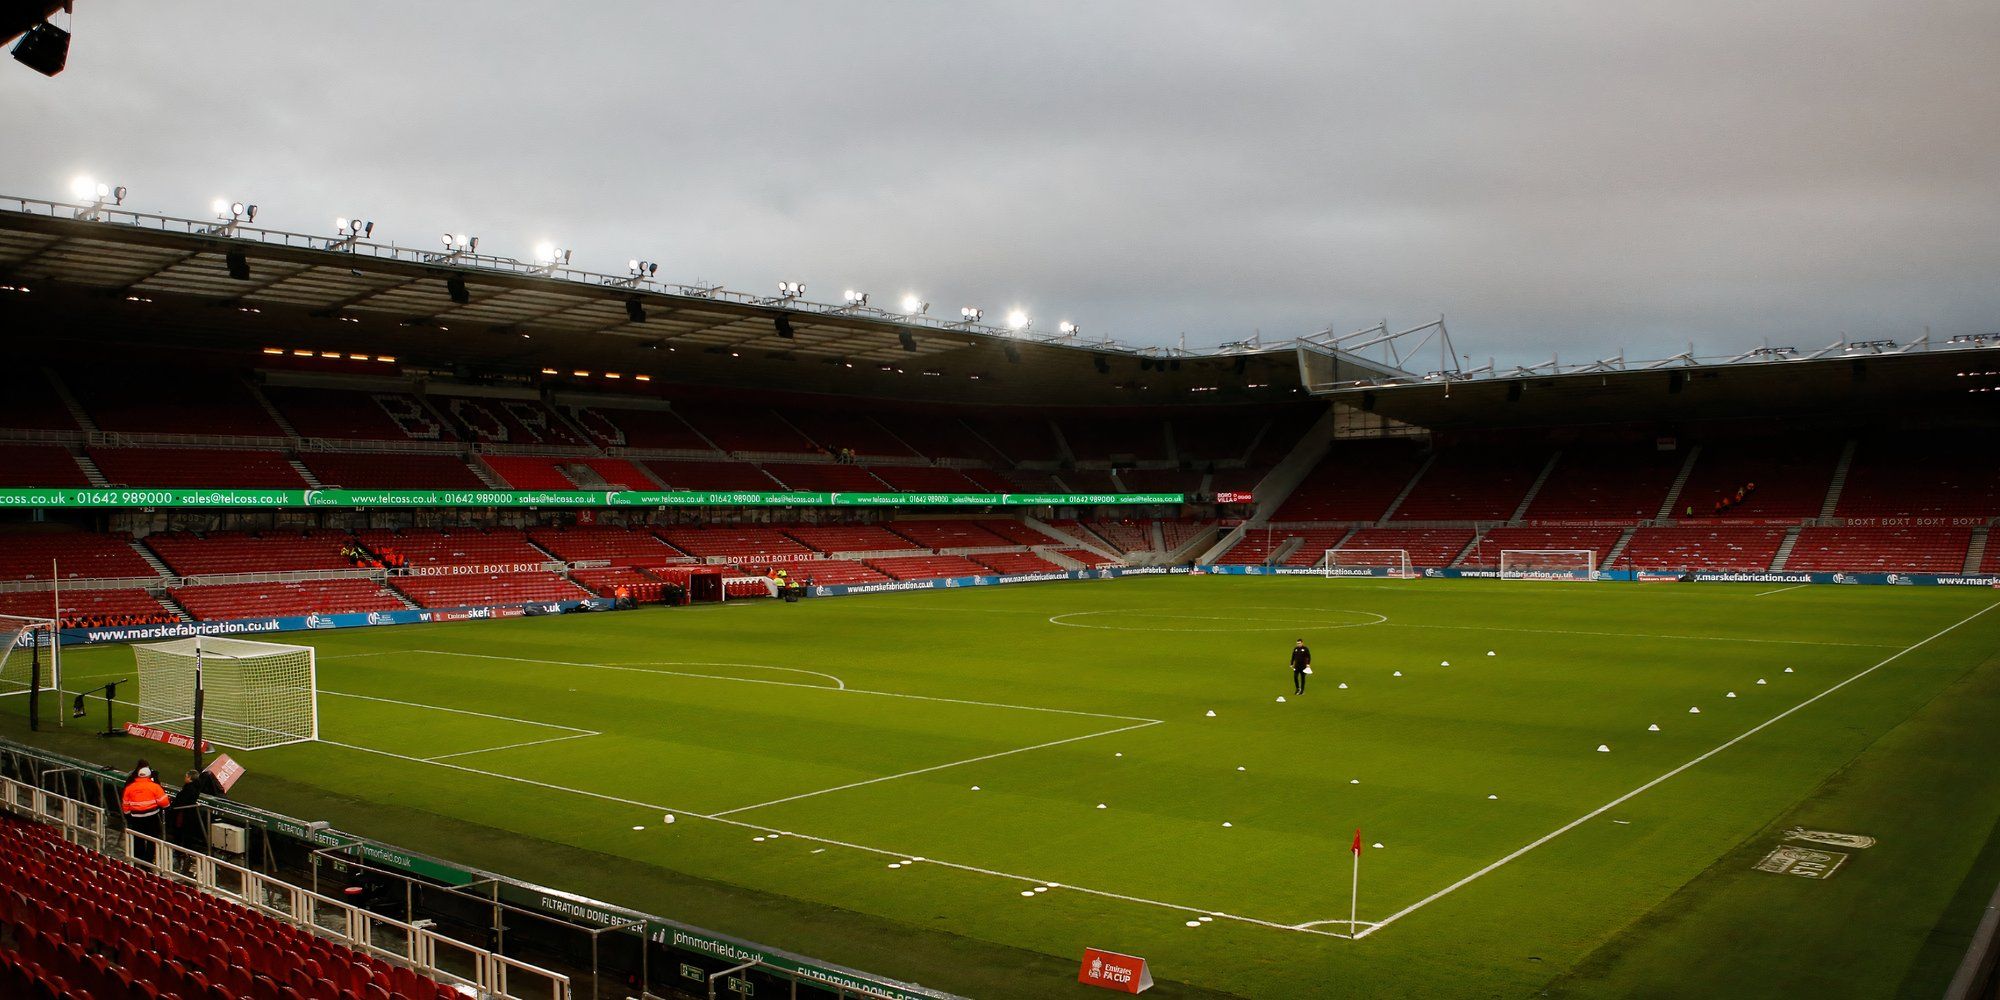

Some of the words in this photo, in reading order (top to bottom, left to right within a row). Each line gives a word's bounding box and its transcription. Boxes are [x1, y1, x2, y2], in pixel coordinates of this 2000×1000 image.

[77, 492, 118, 504] 01642
[122, 492, 172, 504] 989000
[182, 492, 289, 504] sales@telcoss.co.uk
[312, 497, 338, 505] Telcoss
[351, 493, 437, 504] www.telcoss.co.uk
[445, 493, 474, 503] 01642
[476, 493, 512, 503] 989000
[519, 493, 596, 504] sales@telcoss.co.uk
[641, 494, 705, 503] www.telcoss.co.uk
[709, 494, 732, 503] 01642
[733, 494, 760, 503] 989000
[909, 495, 926, 503] 01642
[927, 495, 949, 503] 989000
[1847, 518, 1876, 526] BOXT
[1881, 518, 1910, 526] BOXT
[727, 555, 748, 564] BOXT
[750, 555, 771, 564] BOXT
[772, 554, 792, 563] BOXT
[793, 554, 814, 562] BOXT
[420, 566, 449, 576] BOXT
[452, 565, 481, 575] BOXT
[483, 564, 511, 574] BOXT
[513, 563, 540, 573] BOXT
[847, 580, 934, 593] www.marskefabrication.co.uk
[1937, 577, 2000, 586] www.marsk
[89, 619, 280, 642] www.marskefabrication.co.uk
[320, 834, 340, 847] BETTER
[541, 898, 586, 919] FILTRATION
[586, 908, 609, 925] DONE
[673, 929, 764, 963] johnmorfield.couk
[1105, 964, 1132, 975] Emirates
[1103, 972, 1113, 980] FA
[1114, 974, 1131, 983] CUP
